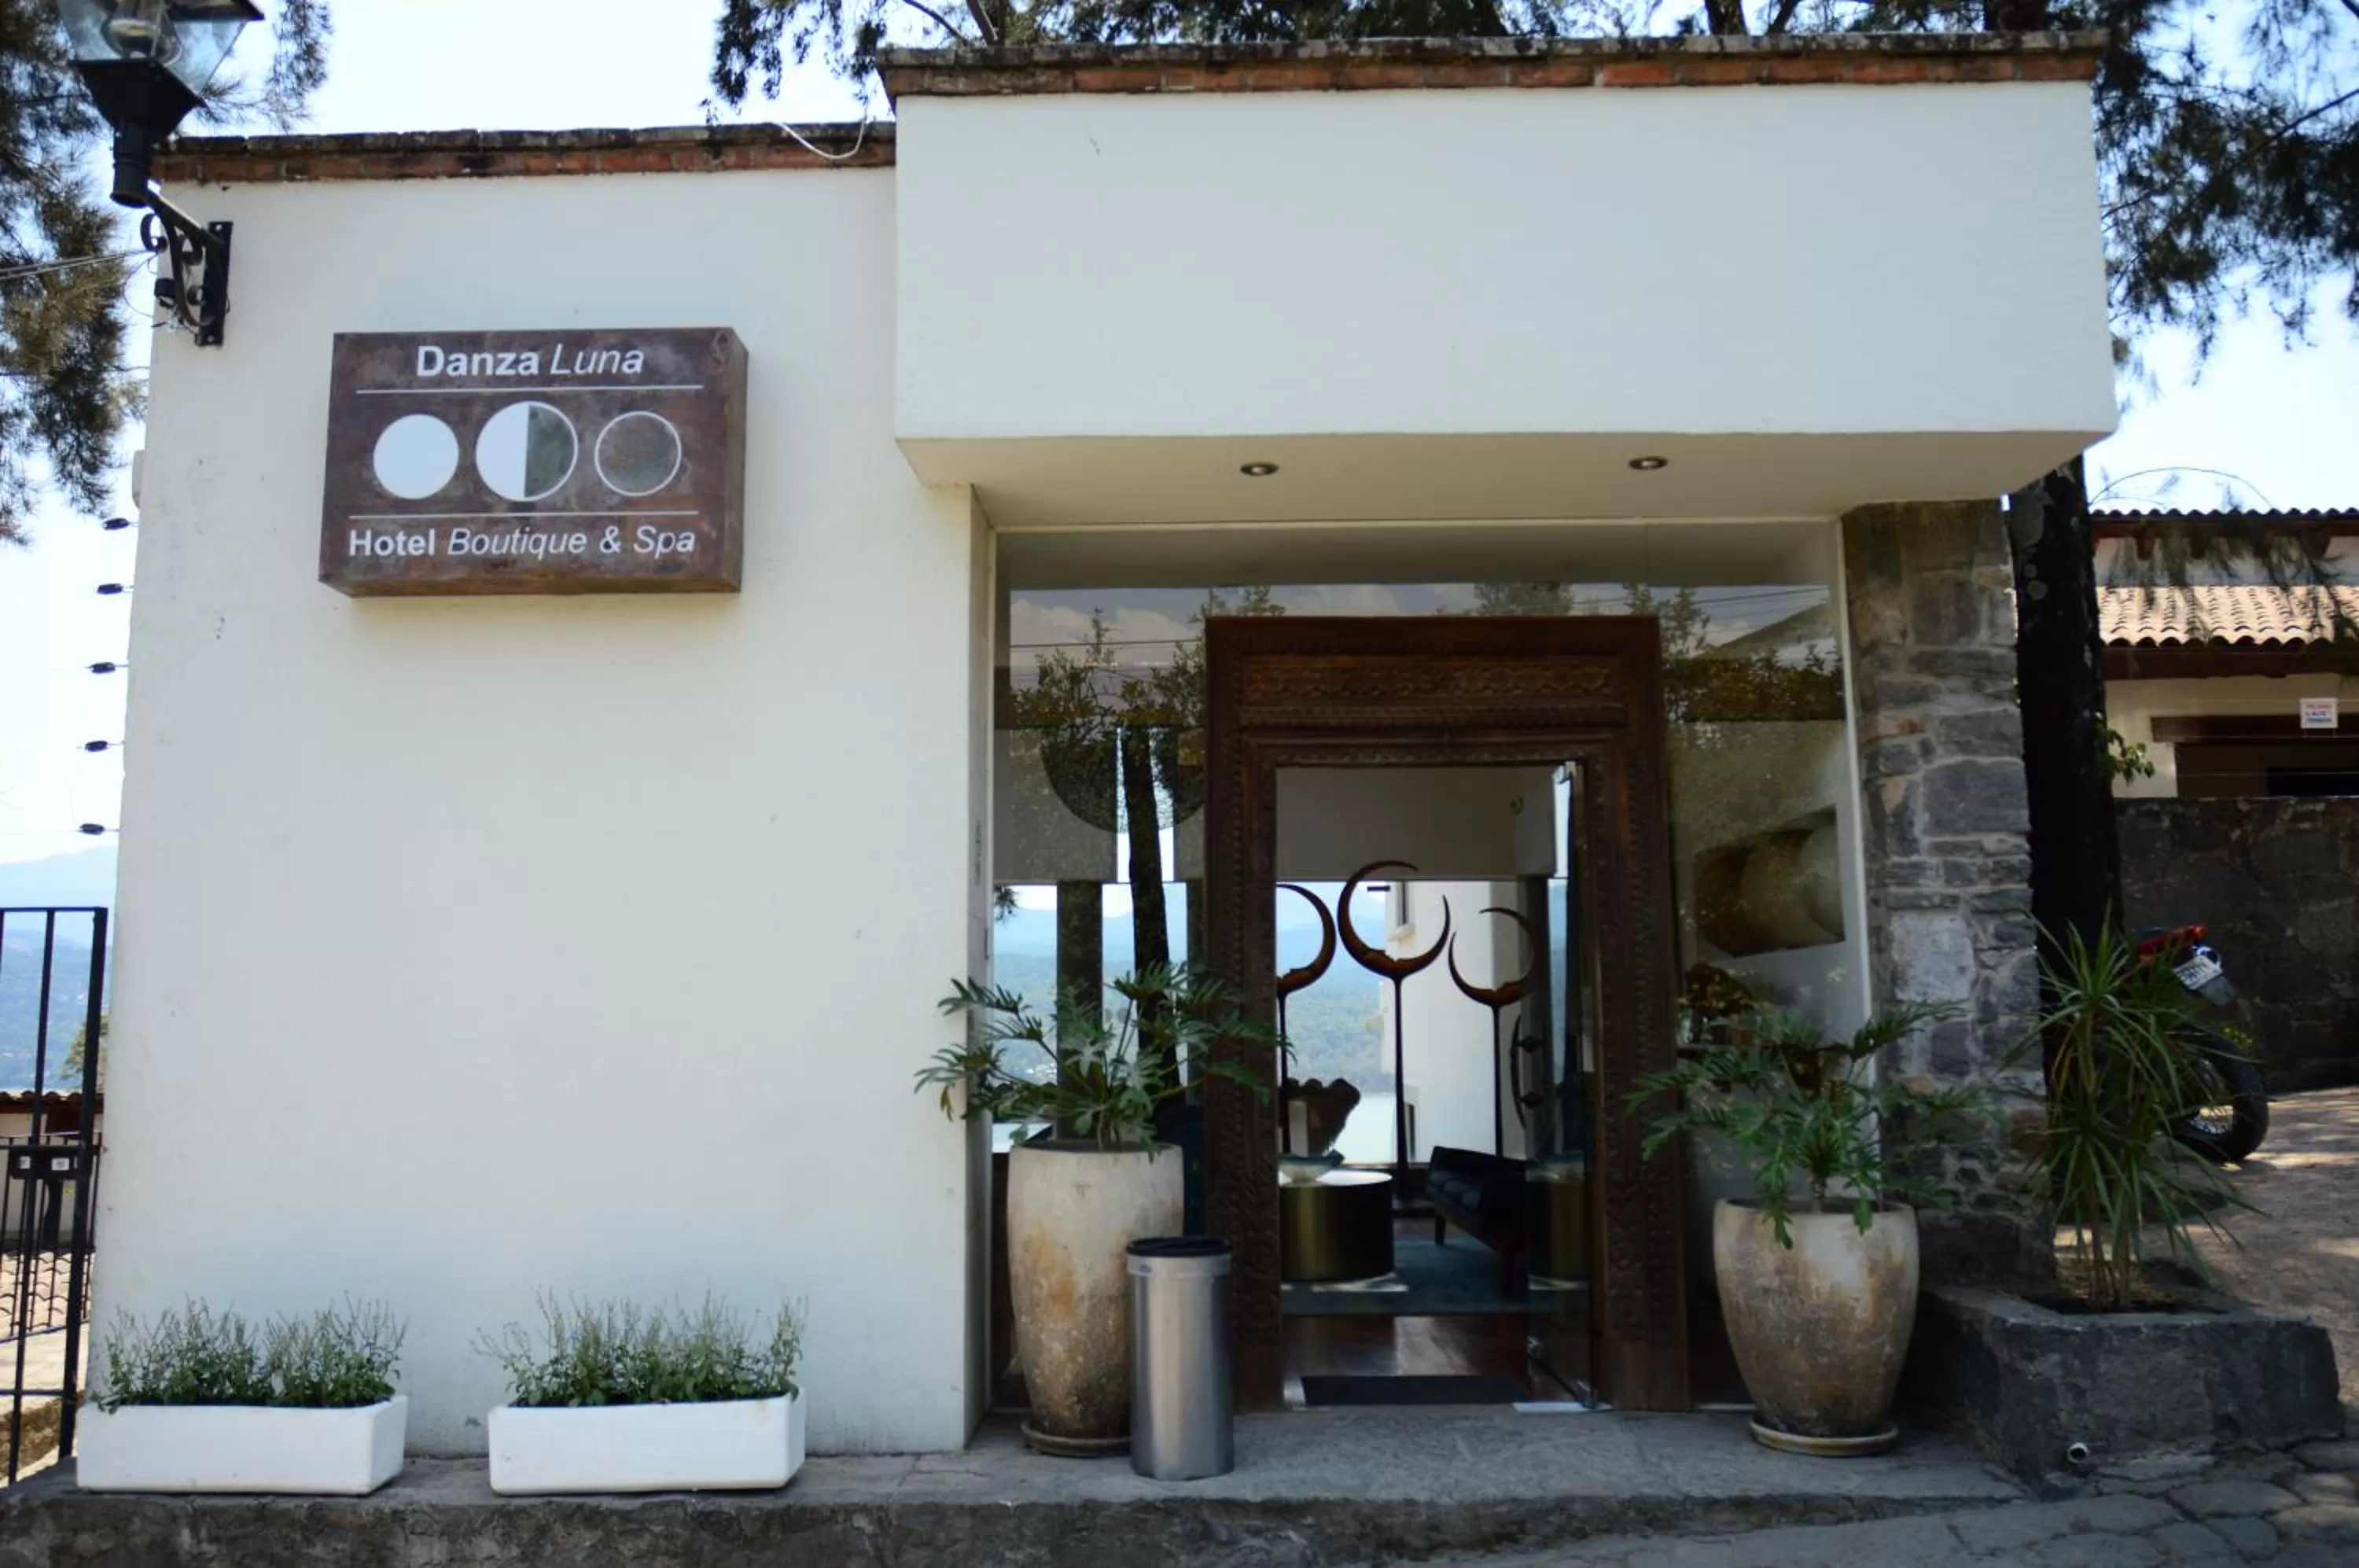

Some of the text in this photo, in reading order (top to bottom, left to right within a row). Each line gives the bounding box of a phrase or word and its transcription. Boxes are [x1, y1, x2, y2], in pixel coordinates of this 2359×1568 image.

[416, 343, 645, 377] Danza Luna
[348, 525, 696, 561] Hotel Boutique & Spa
